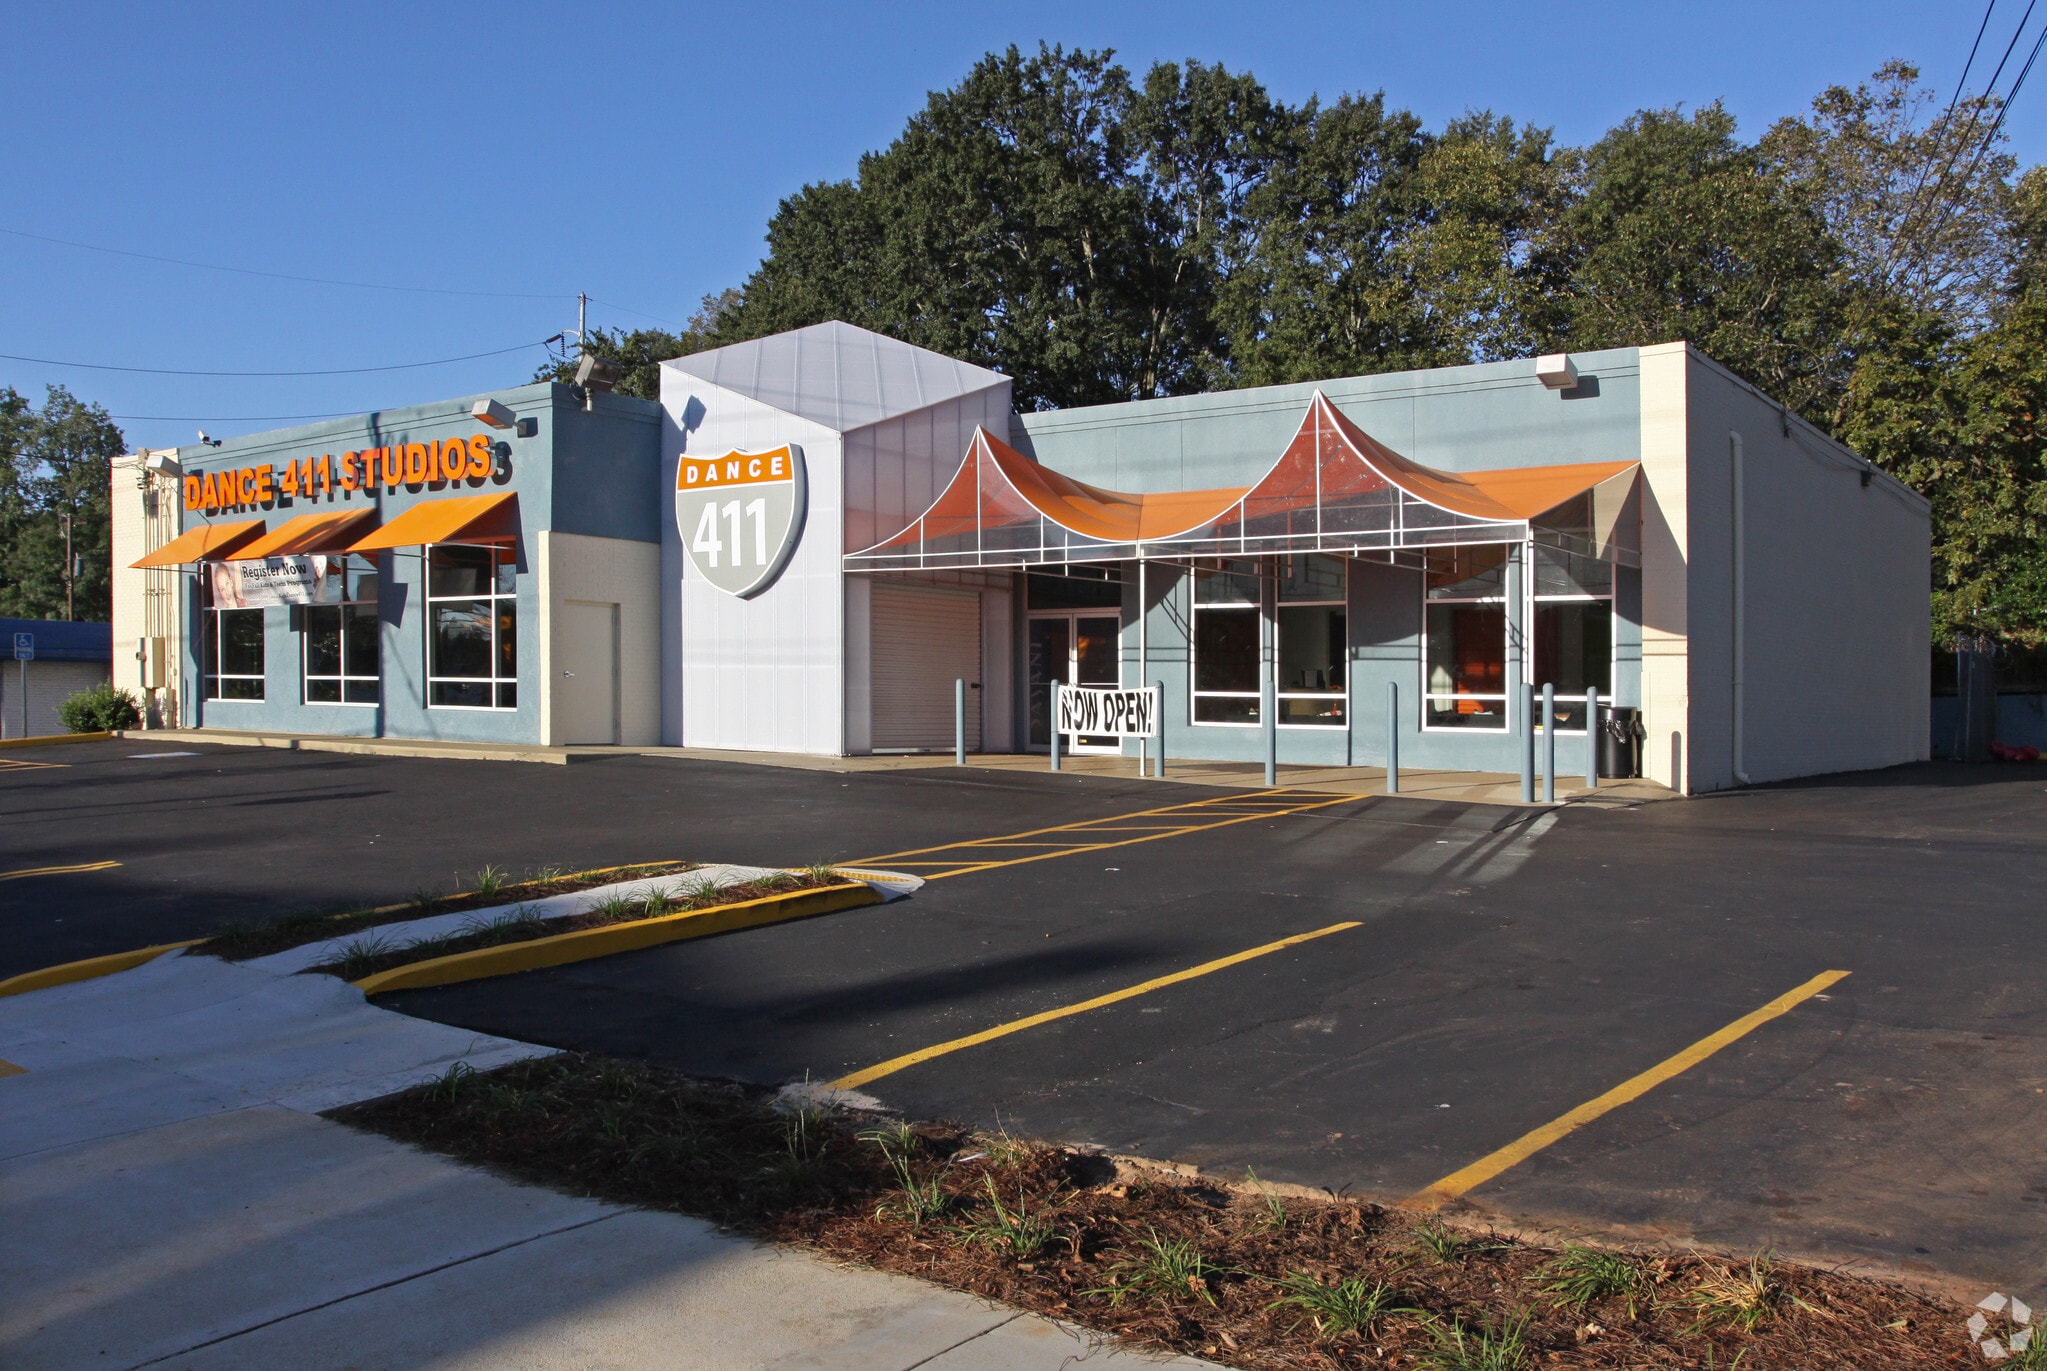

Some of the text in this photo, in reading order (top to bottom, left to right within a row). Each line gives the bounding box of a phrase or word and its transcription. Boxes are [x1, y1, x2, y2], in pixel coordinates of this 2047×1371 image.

[185, 433, 493, 511] DANCE 411 STUDIOS
[686, 456, 783, 484] DANCE
[692, 497, 767, 568] 411
[242, 563, 307, 581] Register Now
[287, 579, 312, 587] Programs
[1062, 690, 1153, 733] NOW OPEN!
